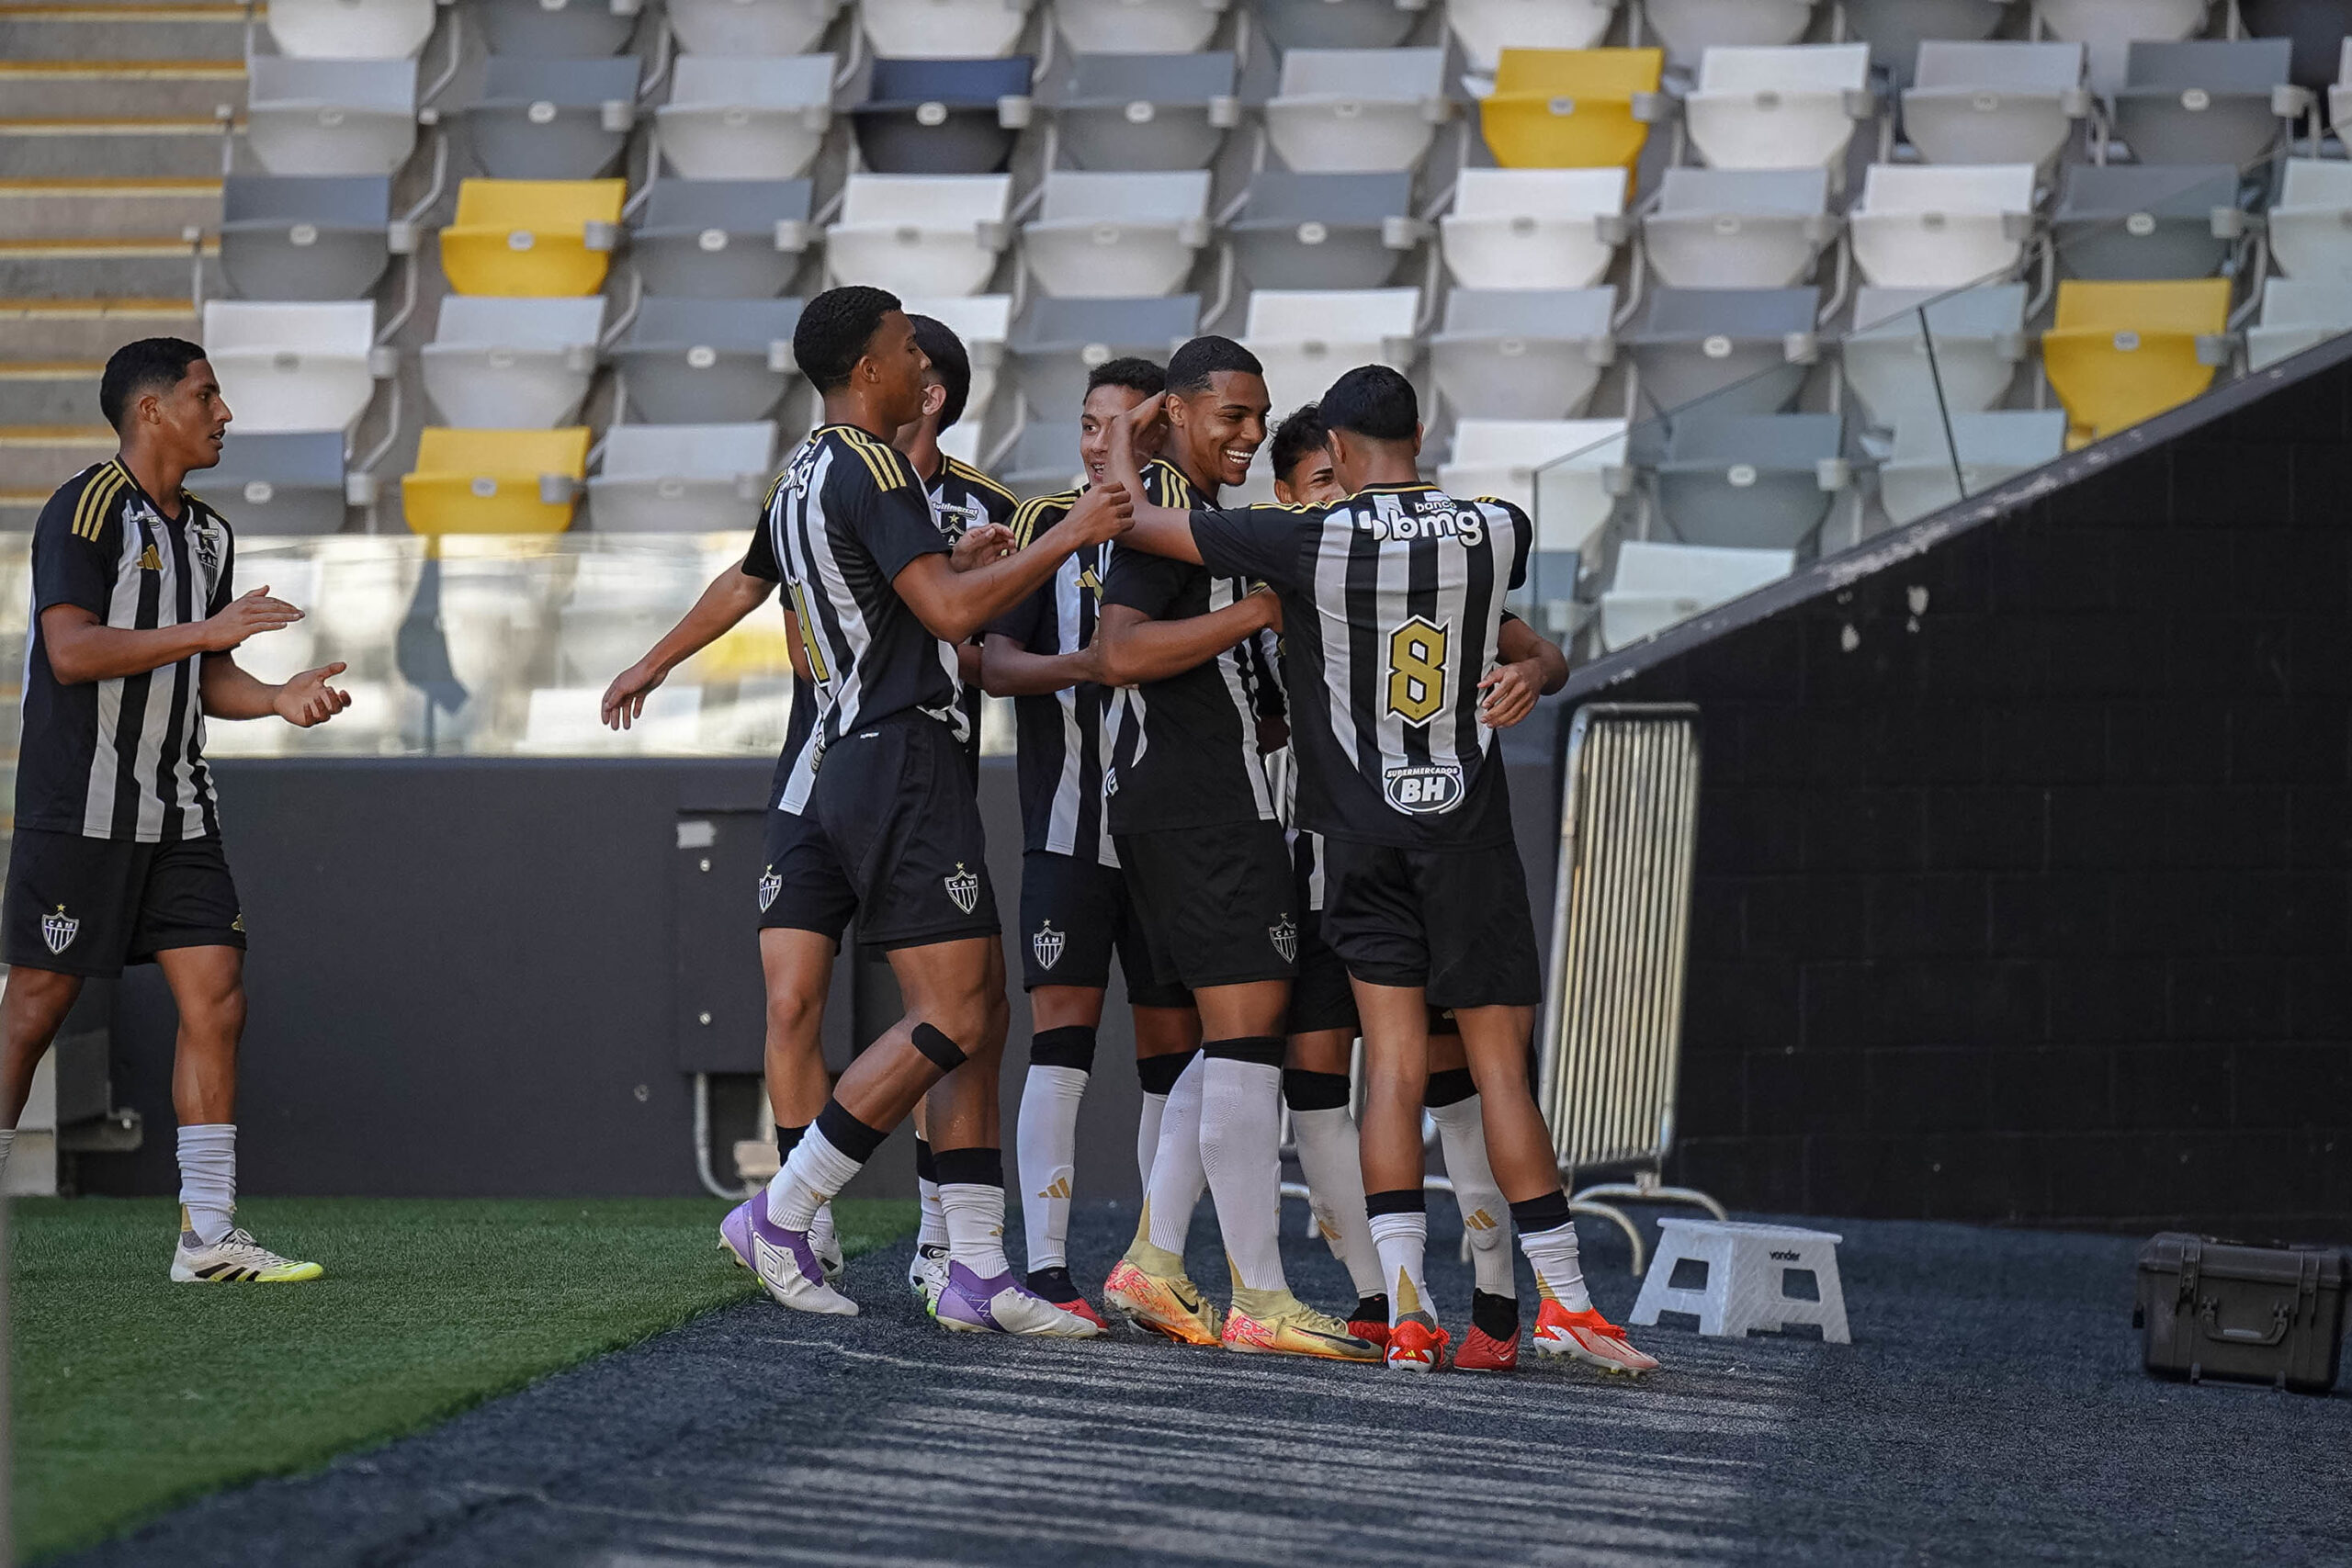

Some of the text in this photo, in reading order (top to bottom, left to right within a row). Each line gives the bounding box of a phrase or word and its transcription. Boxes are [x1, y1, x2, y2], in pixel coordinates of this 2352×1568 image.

[1415, 501, 1457, 513] banco
[1389, 509, 1483, 547] bmg
[1385, 616, 1452, 727] 8
[1386, 767, 1459, 779] SUPERMERCADOS
[1399, 777, 1446, 804] BH
[951, 880, 976, 888] CAM
[48, 919, 74, 930] CAM
